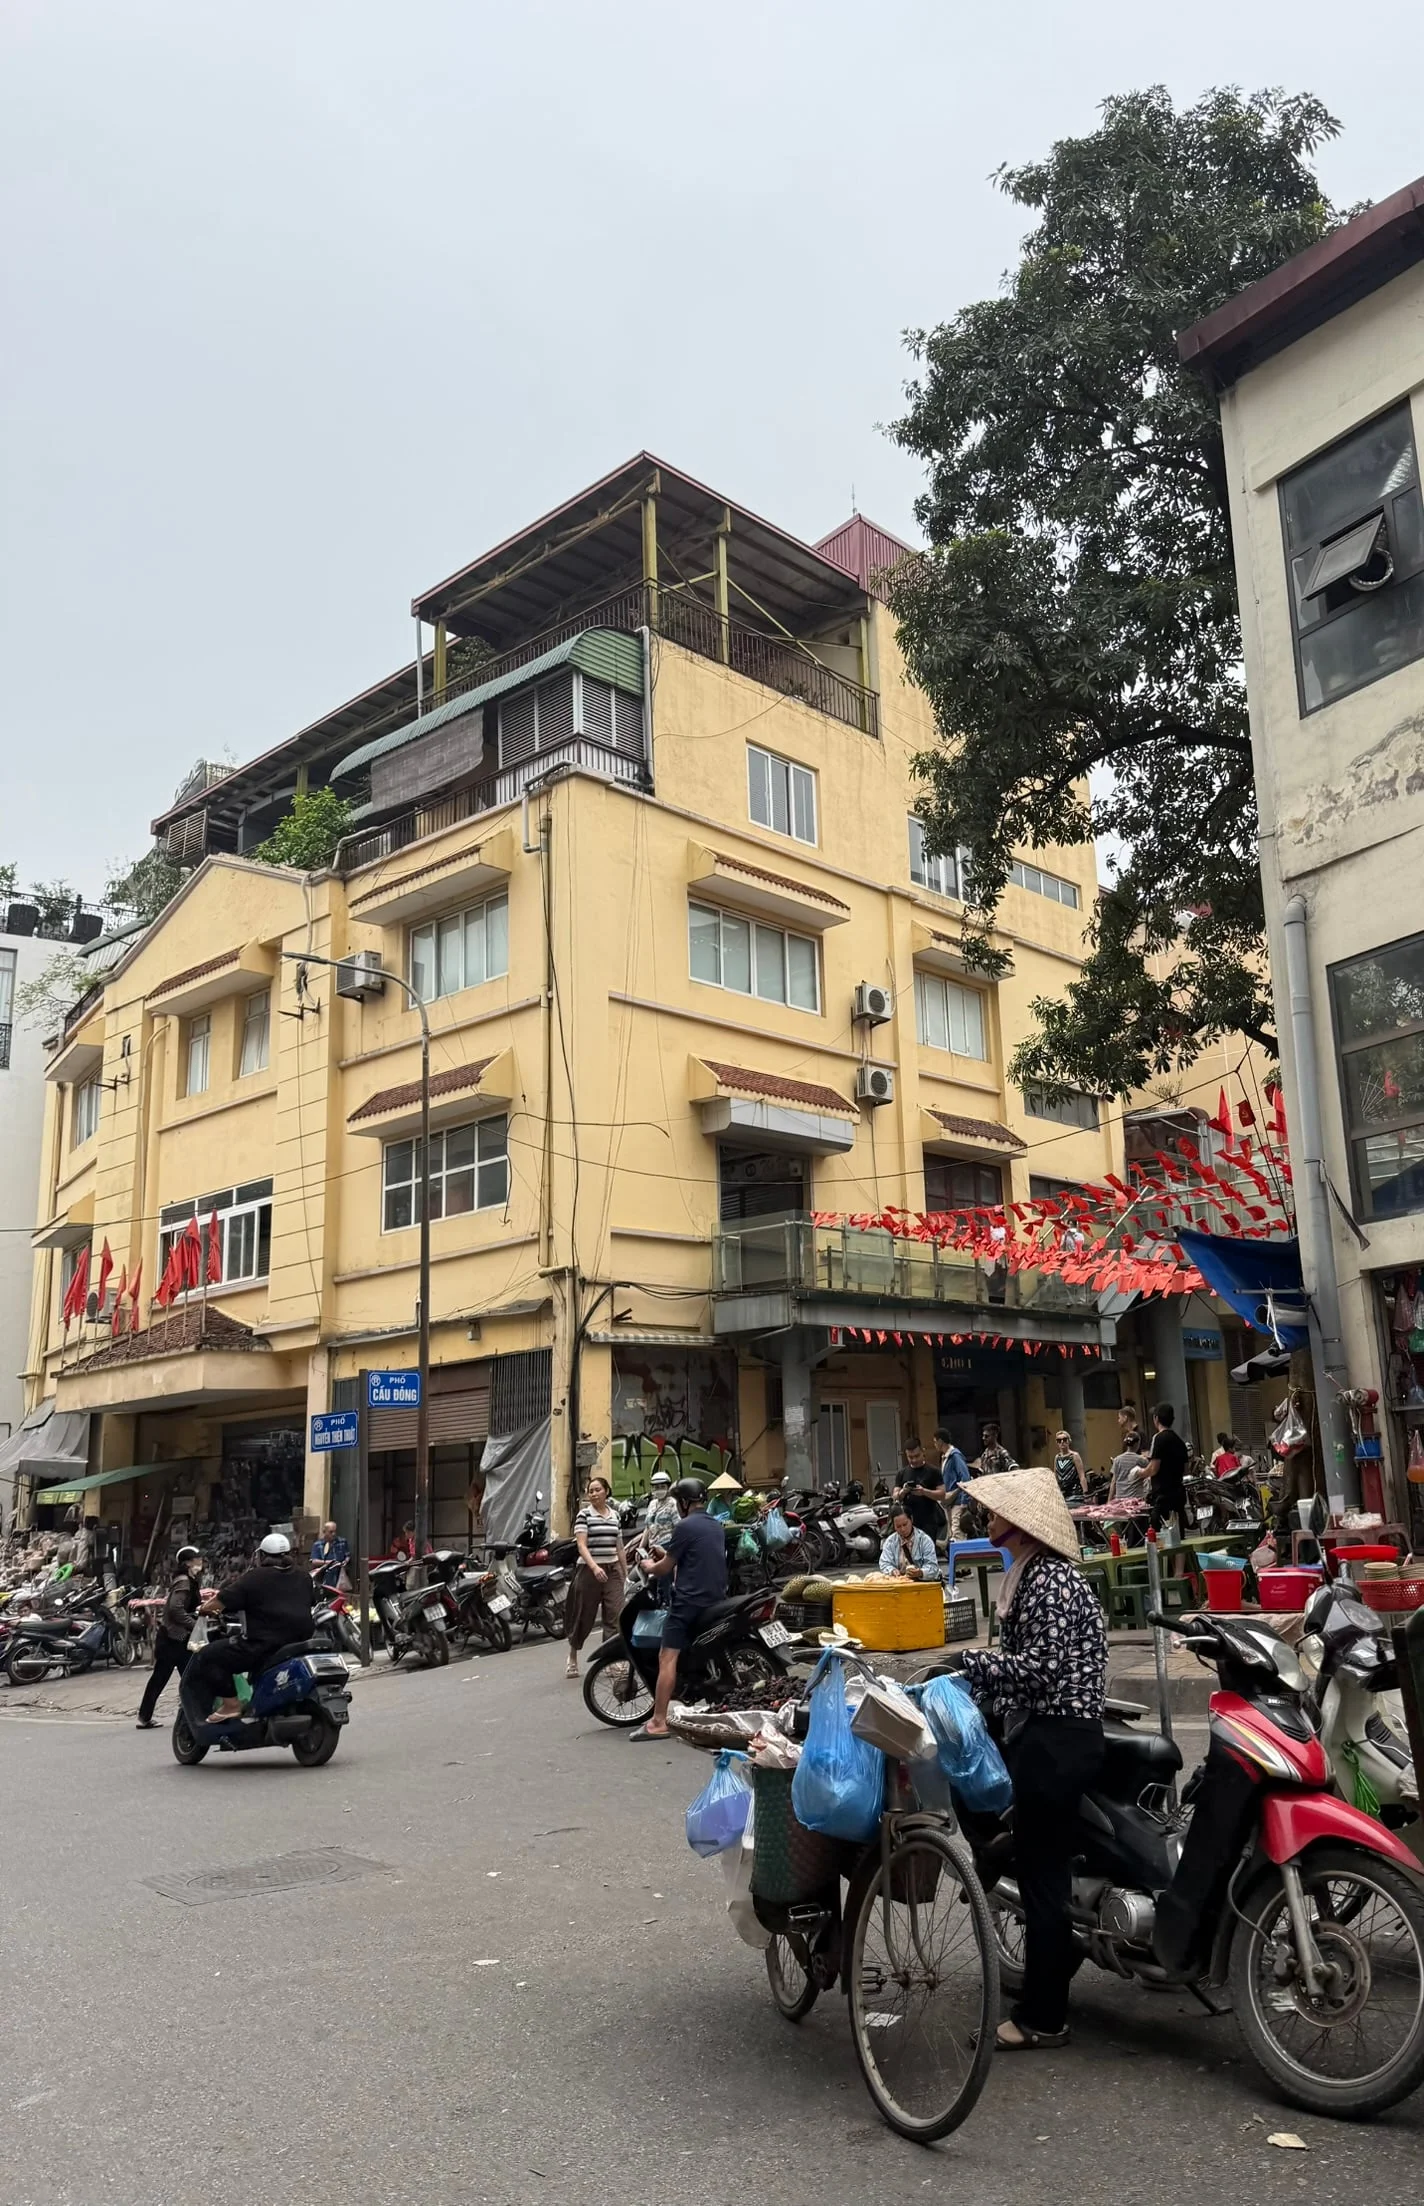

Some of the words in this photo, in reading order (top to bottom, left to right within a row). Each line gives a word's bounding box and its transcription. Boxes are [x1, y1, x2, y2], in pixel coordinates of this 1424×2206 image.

[389, 1375, 406, 1384] PHỐ
[393, 1386, 417, 1401] ĐÔNG
[330, 1415, 346, 1426] PHỐ
